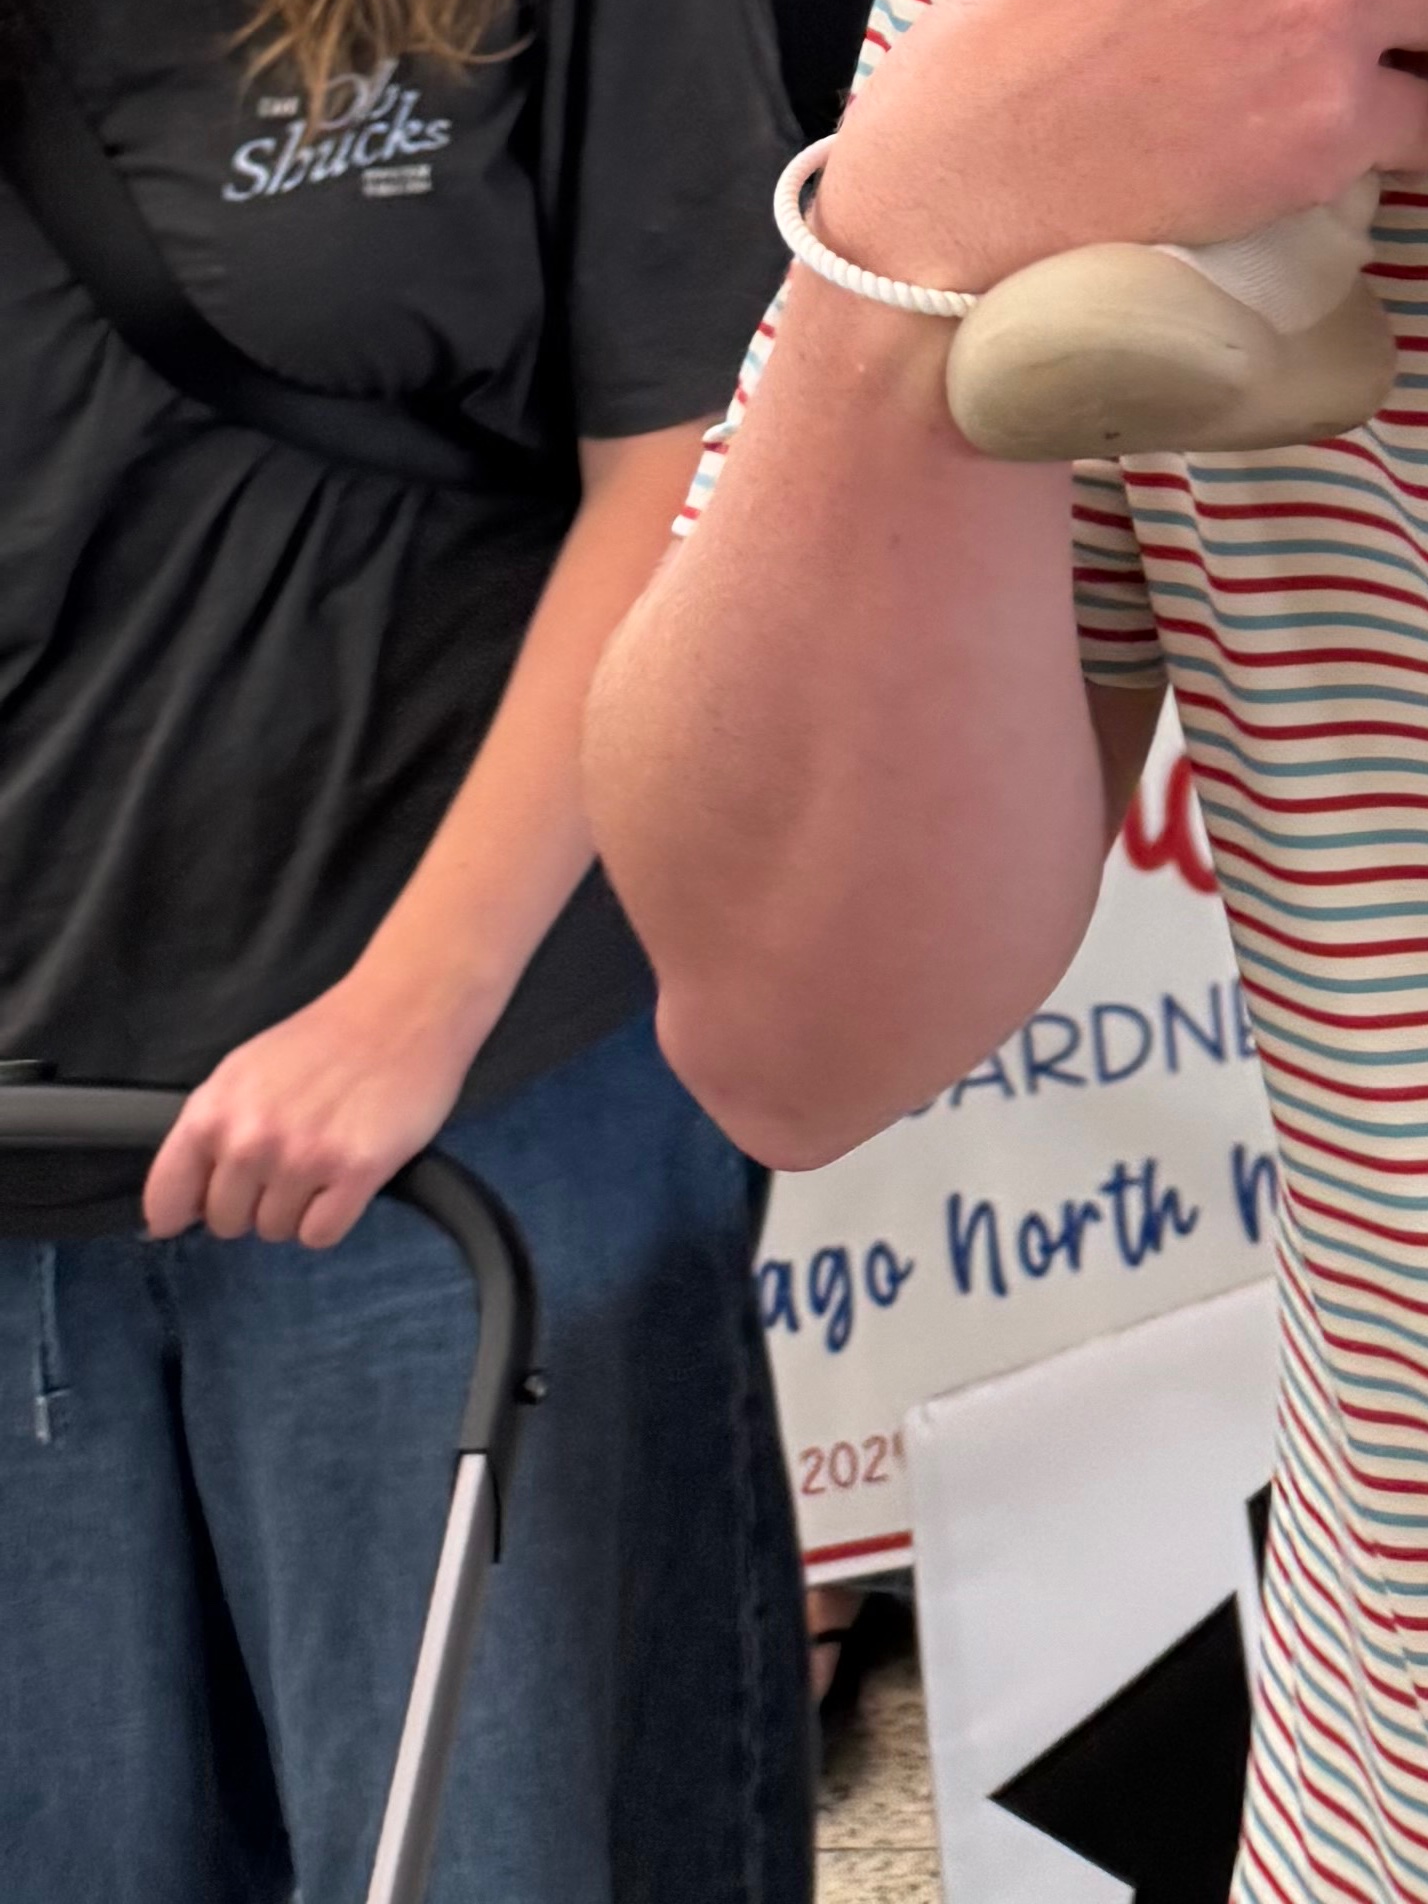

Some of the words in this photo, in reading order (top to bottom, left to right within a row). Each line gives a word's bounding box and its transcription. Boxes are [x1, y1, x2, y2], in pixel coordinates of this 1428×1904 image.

[221, 89, 452, 203] Shucks
[905, 978, 1258, 1118] ARDNE
[755, 1239, 915, 1354] ago
[947, 1158, 1200, 1298] North
[799, 1431, 905, 1496] 202
